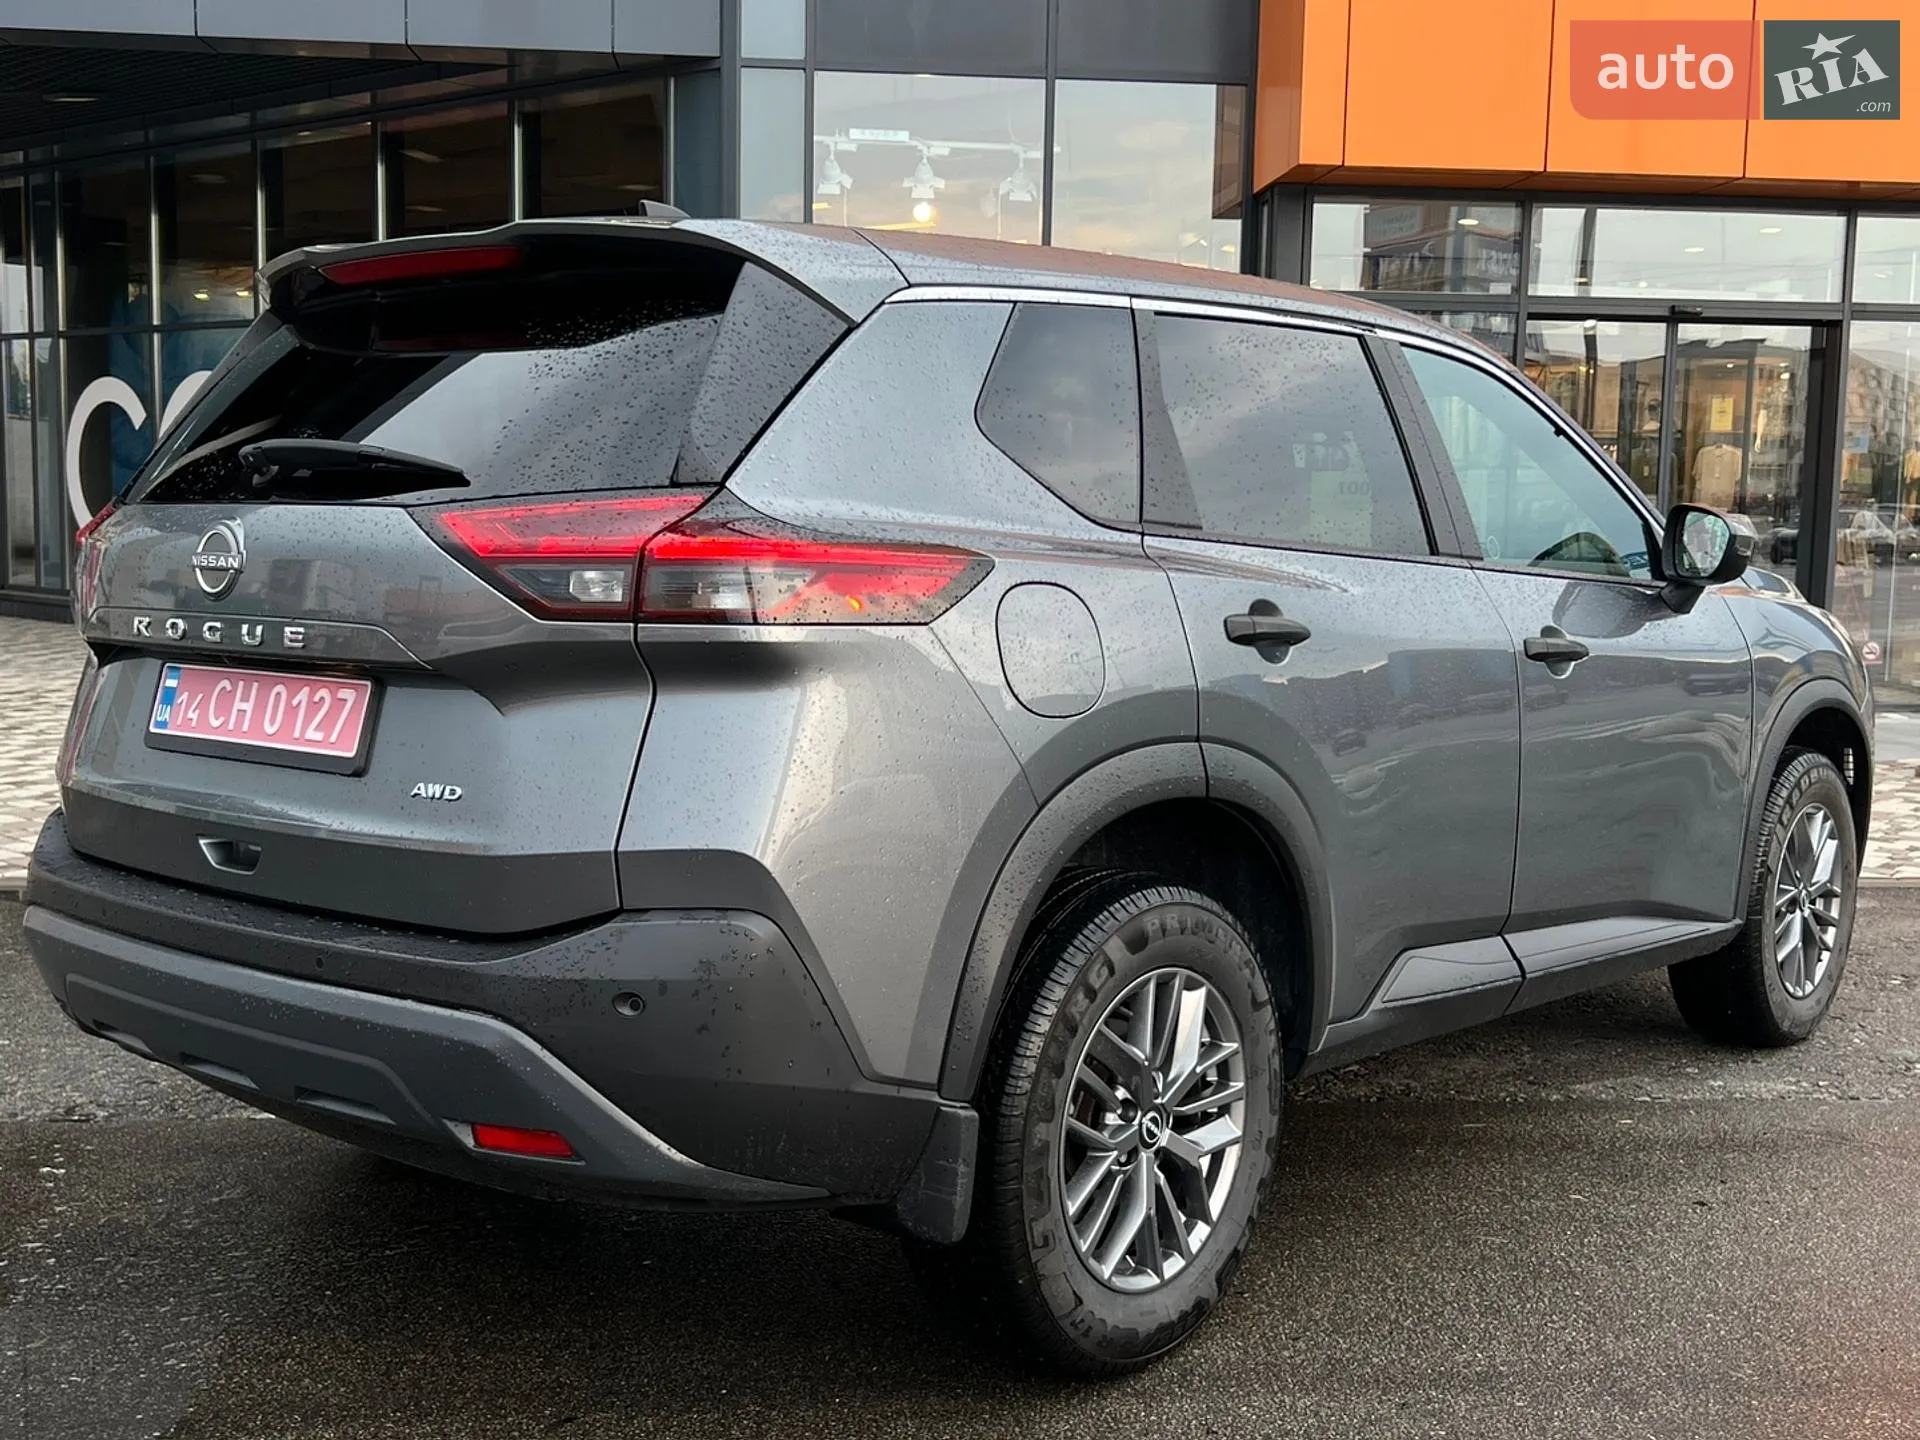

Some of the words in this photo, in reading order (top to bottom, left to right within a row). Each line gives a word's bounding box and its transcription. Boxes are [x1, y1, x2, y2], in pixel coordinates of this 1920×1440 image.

[191, 554, 239, 568] NISSAN
[133, 615, 306, 648] ROGUE
[157, 704, 171, 722] UA
[176, 691, 205, 728] 14
[207, 678, 260, 733] CH
[262, 683, 358, 744] 0127
[410, 782, 463, 801] AWD
